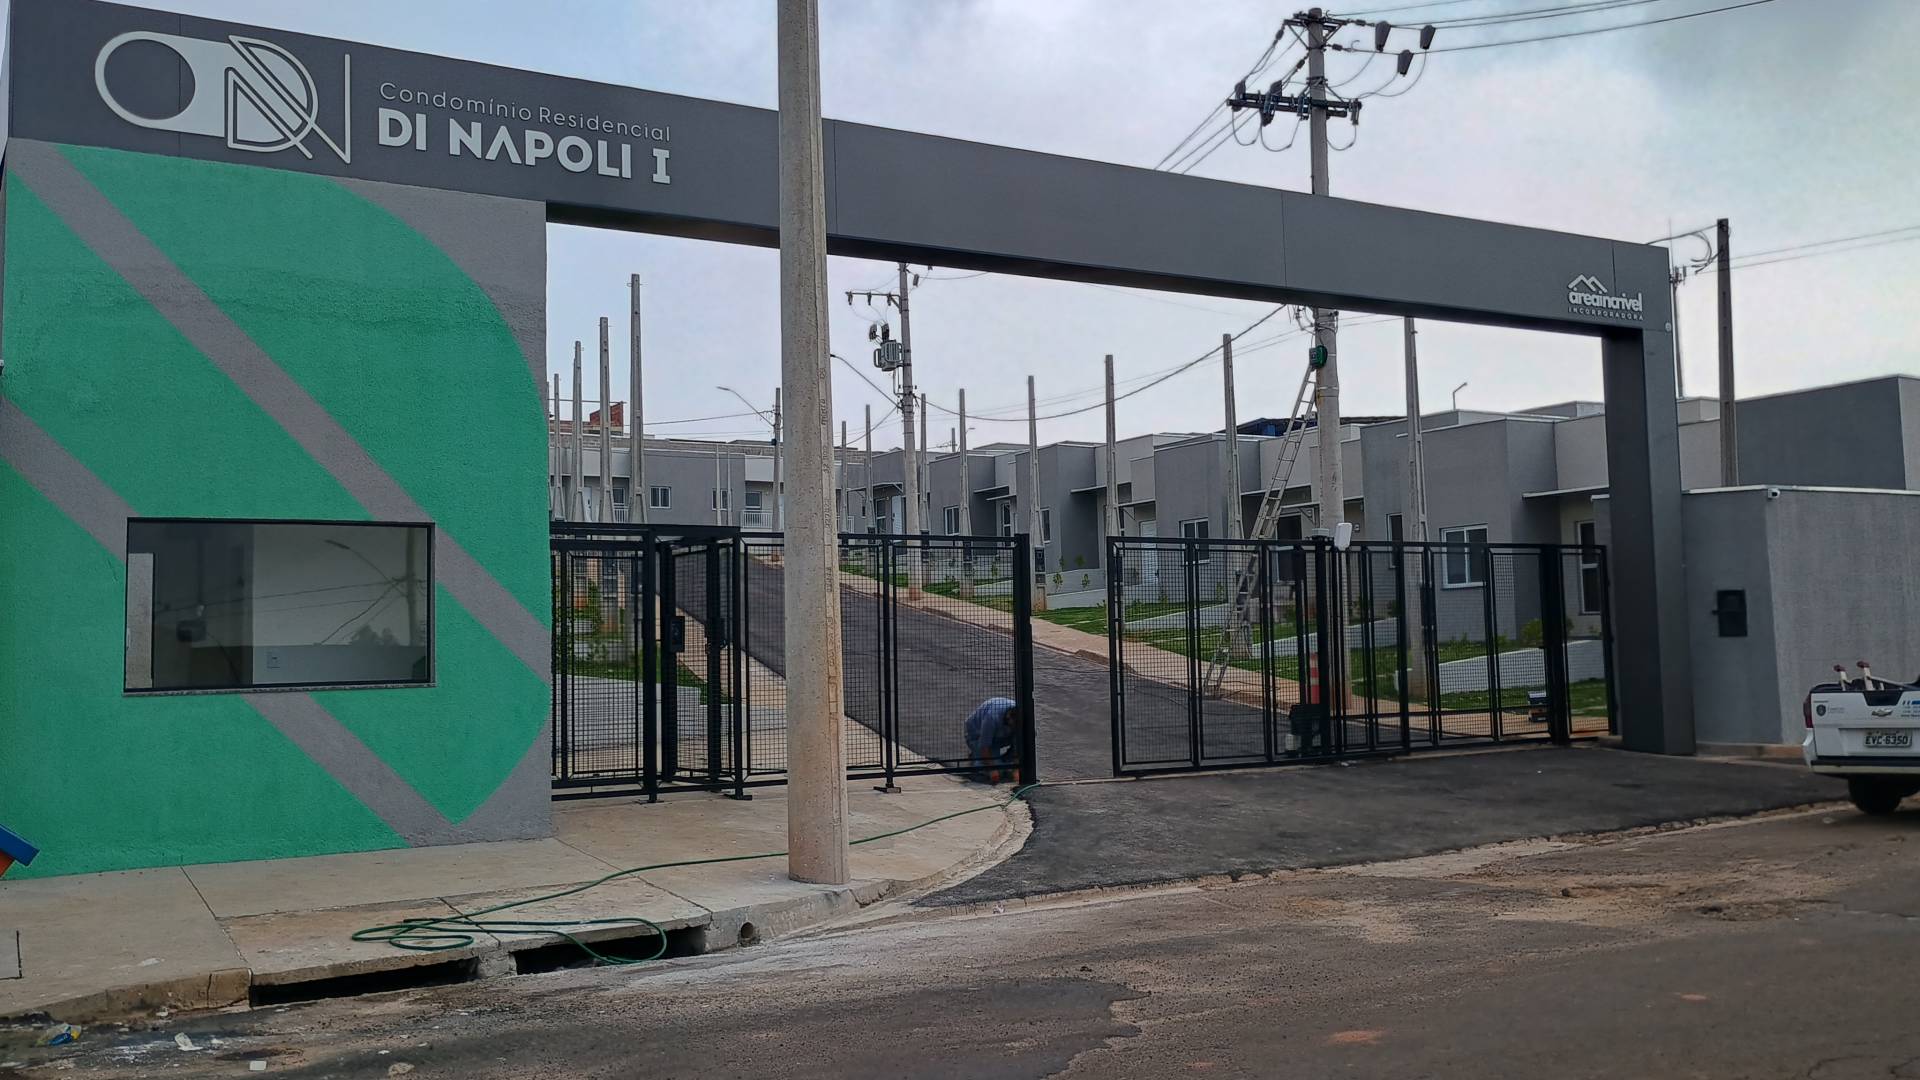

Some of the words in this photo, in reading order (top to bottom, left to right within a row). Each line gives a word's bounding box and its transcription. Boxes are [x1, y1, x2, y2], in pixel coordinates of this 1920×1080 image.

[378, 107, 427, 151] DI
[449, 118, 632, 179] NAPOLI
[652, 147, 671, 184] I
[379, 82, 532, 121] Condomínio
[539, 106, 671, 142] Residencial
